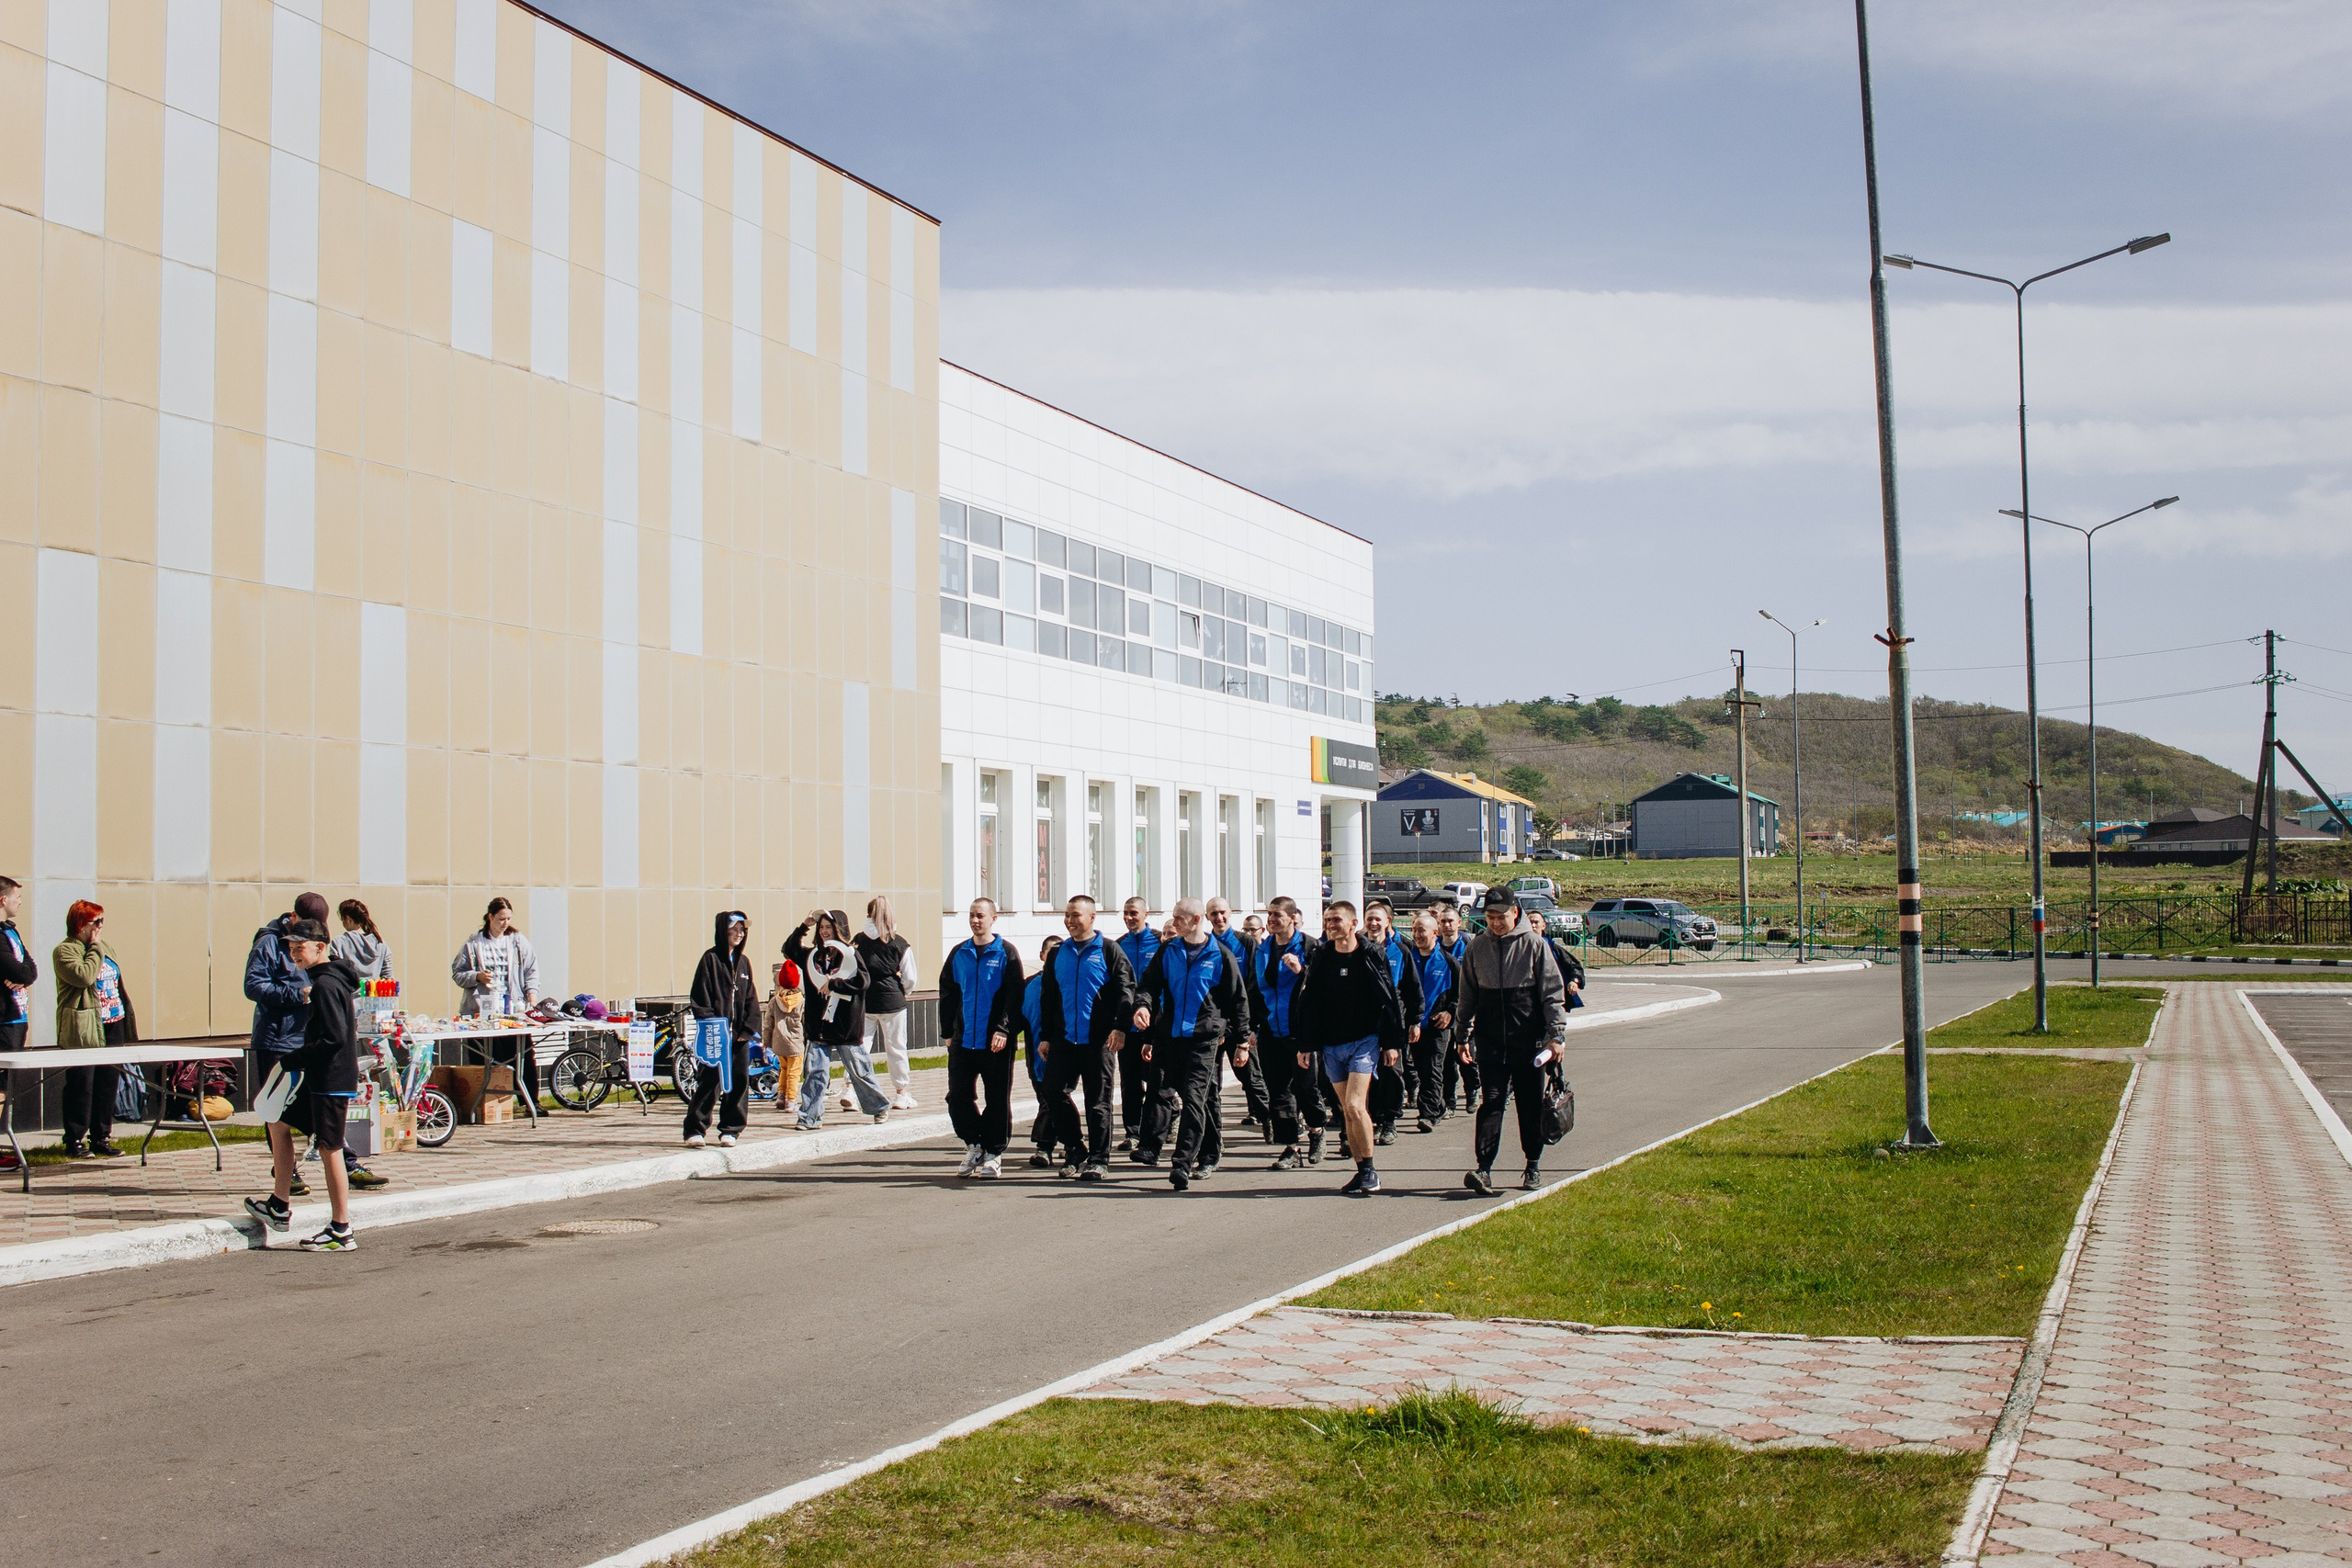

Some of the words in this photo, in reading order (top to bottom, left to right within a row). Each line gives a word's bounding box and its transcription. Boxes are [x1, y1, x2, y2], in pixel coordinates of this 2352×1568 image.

[1358, 761, 1374, 772] БИЗНЕСА
[714, 1024, 719, 1034] ТЫ
[706, 1024, 714, 1058] РЕКОРДЫ!
